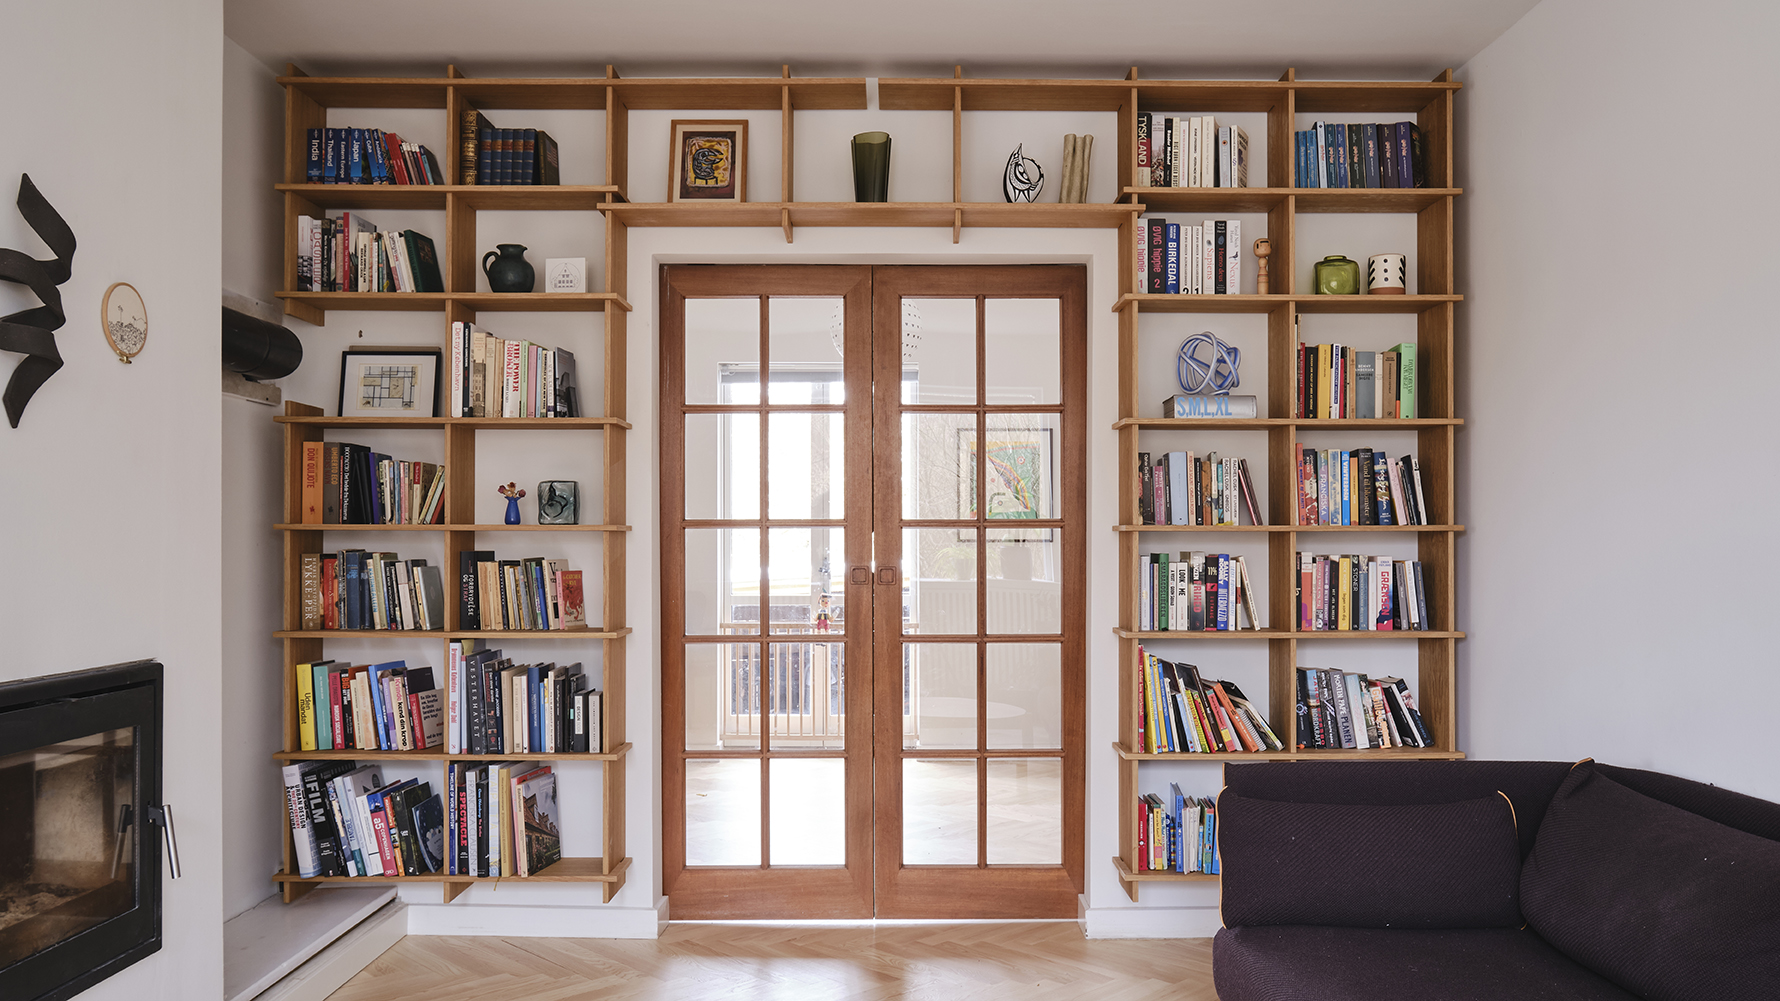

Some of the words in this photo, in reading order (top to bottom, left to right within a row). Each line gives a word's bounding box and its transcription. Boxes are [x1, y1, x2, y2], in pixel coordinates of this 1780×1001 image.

[311, 140, 319, 161] India
[352, 140, 360, 162] Japan
[1138, 116, 1147, 164] TYSKLAND
[1137, 226, 1145, 245] ØVIG
[1153, 226, 1162, 245] ØVIG
[1151, 249, 1162, 272] hippie
[1168, 242, 1177, 285] BIRKEDAL
[1205, 248, 1214, 280] Sapiens
[1154, 279, 1161, 288] 2
[1230, 262, 1238, 288] Nexus
[1177, 397, 1232, 417] S,M,L,XL
[1179, 588, 1185, 596] ME
[1193, 581, 1202, 613] FRIHED
[1218, 588, 1227, 621] INTERMEZZO
[1381, 572, 1390, 615] GRÆNSEN
[342, 678, 350, 689] BIG
[1333, 675, 1344, 699] MORTEN
[470, 660, 480, 737] VESTERHAVET
[1338, 700, 1346, 715] PAPE
[1372, 689, 1383, 721] Guillou
[1311, 708, 1321, 745] NORDKRAFT
[1317, 708, 1325, 746] EJERSBO
[1341, 716, 1352, 744] PLANEN
[295, 784, 303, 805] URBAN
[306, 782, 326, 823] FILM
[467, 780, 476, 825] FRANCISKA
[298, 806, 306, 829] DESIGN
[373, 818, 384, 829] a5
[380, 829, 391, 860] COPENHAGEN
[469, 828, 477, 865] CLAUSEN
